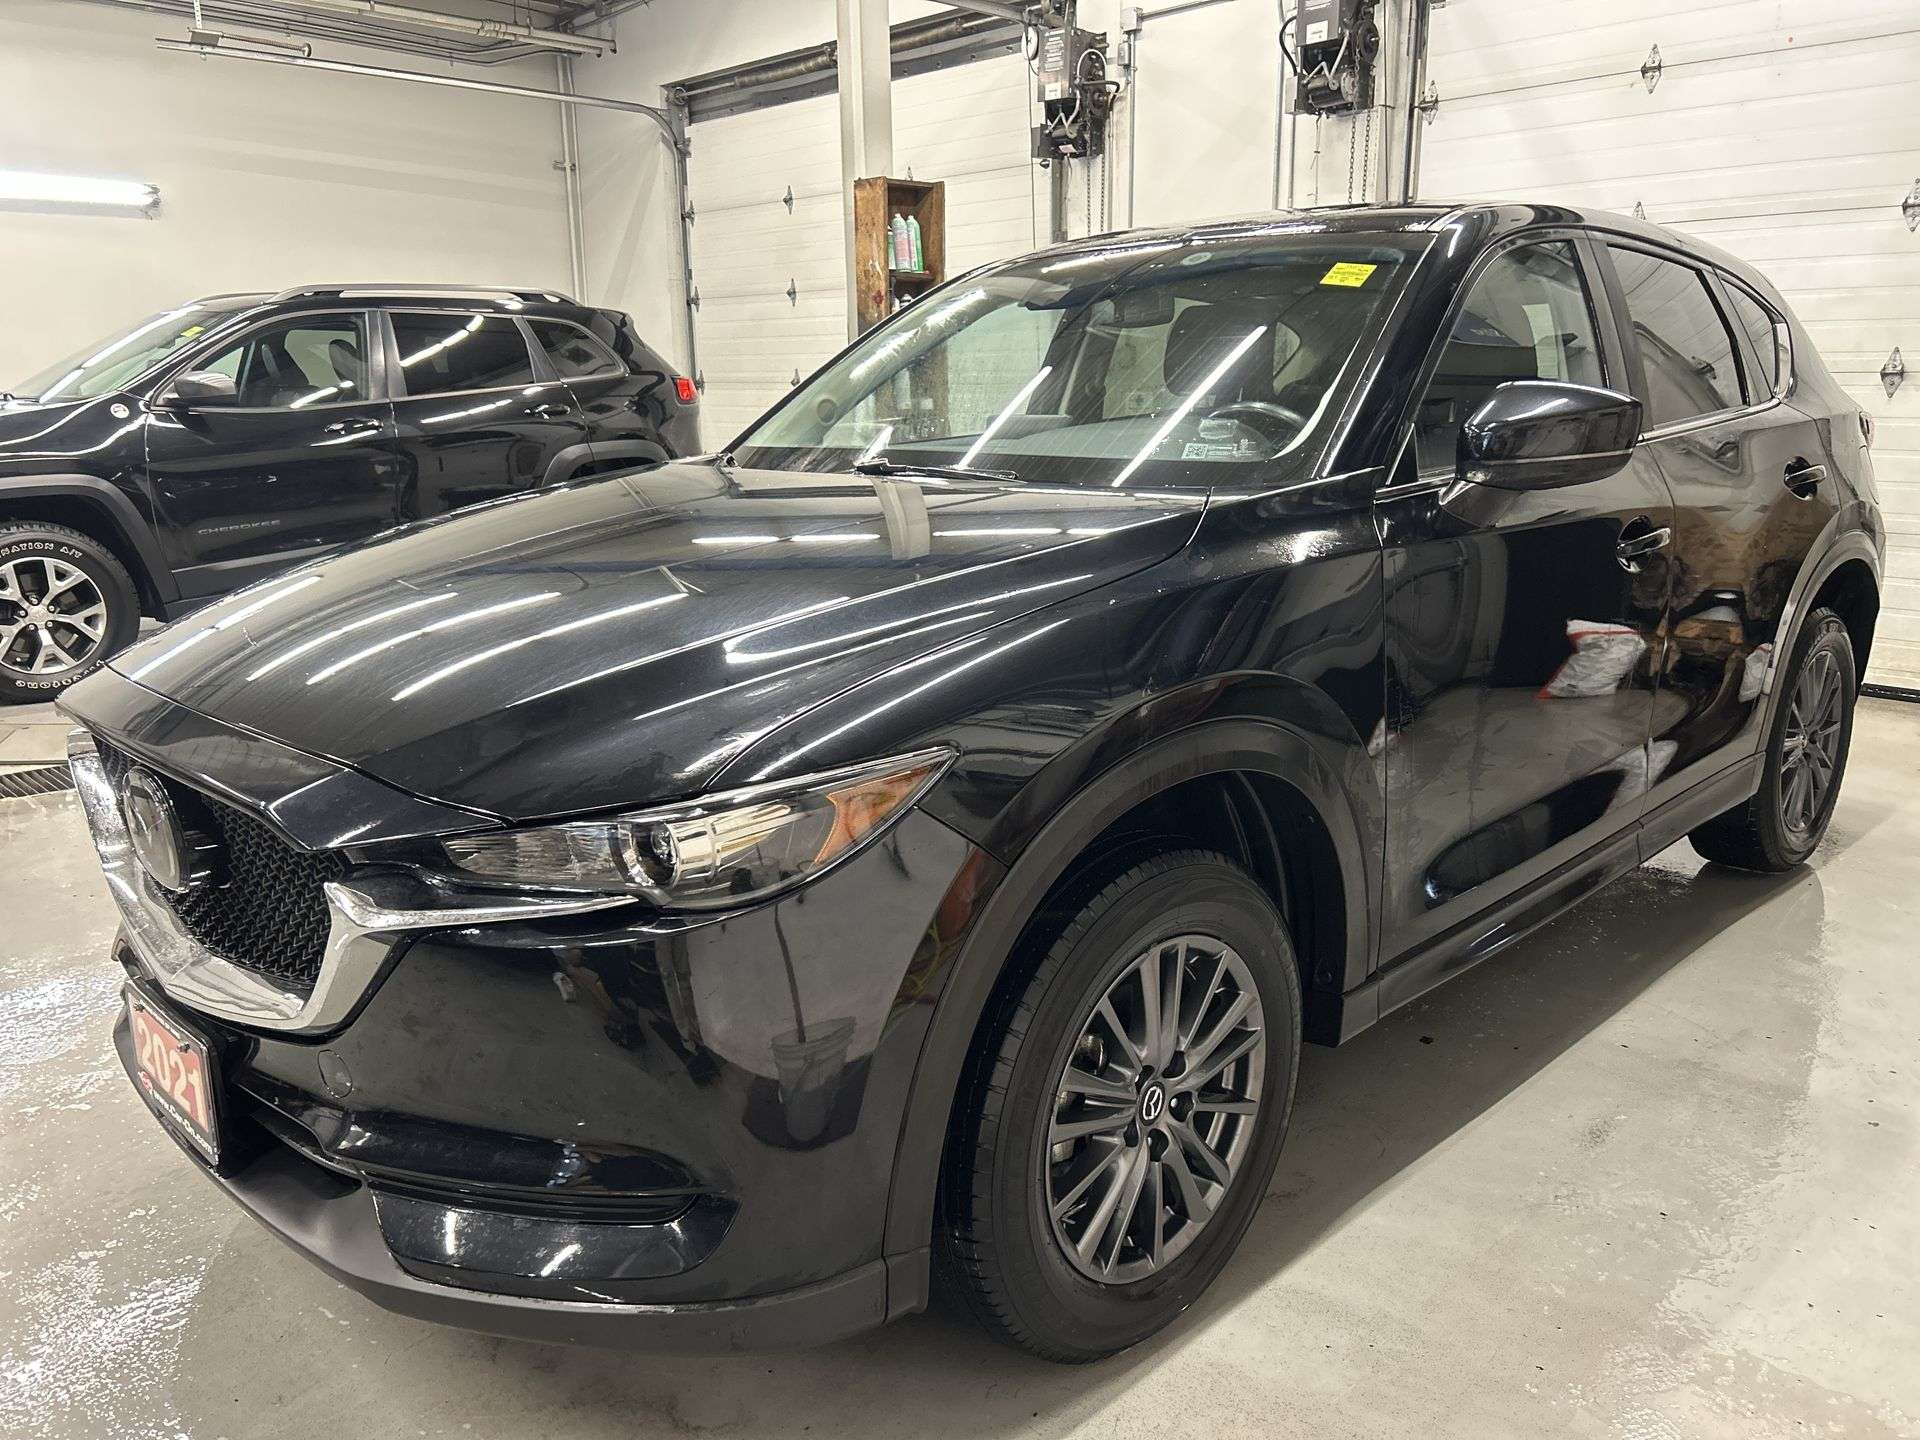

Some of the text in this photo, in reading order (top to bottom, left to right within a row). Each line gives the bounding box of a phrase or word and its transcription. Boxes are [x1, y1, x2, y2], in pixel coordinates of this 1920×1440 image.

[0, 542, 83, 559] NATION A/T
[137, 1016, 209, 1133] 2021
